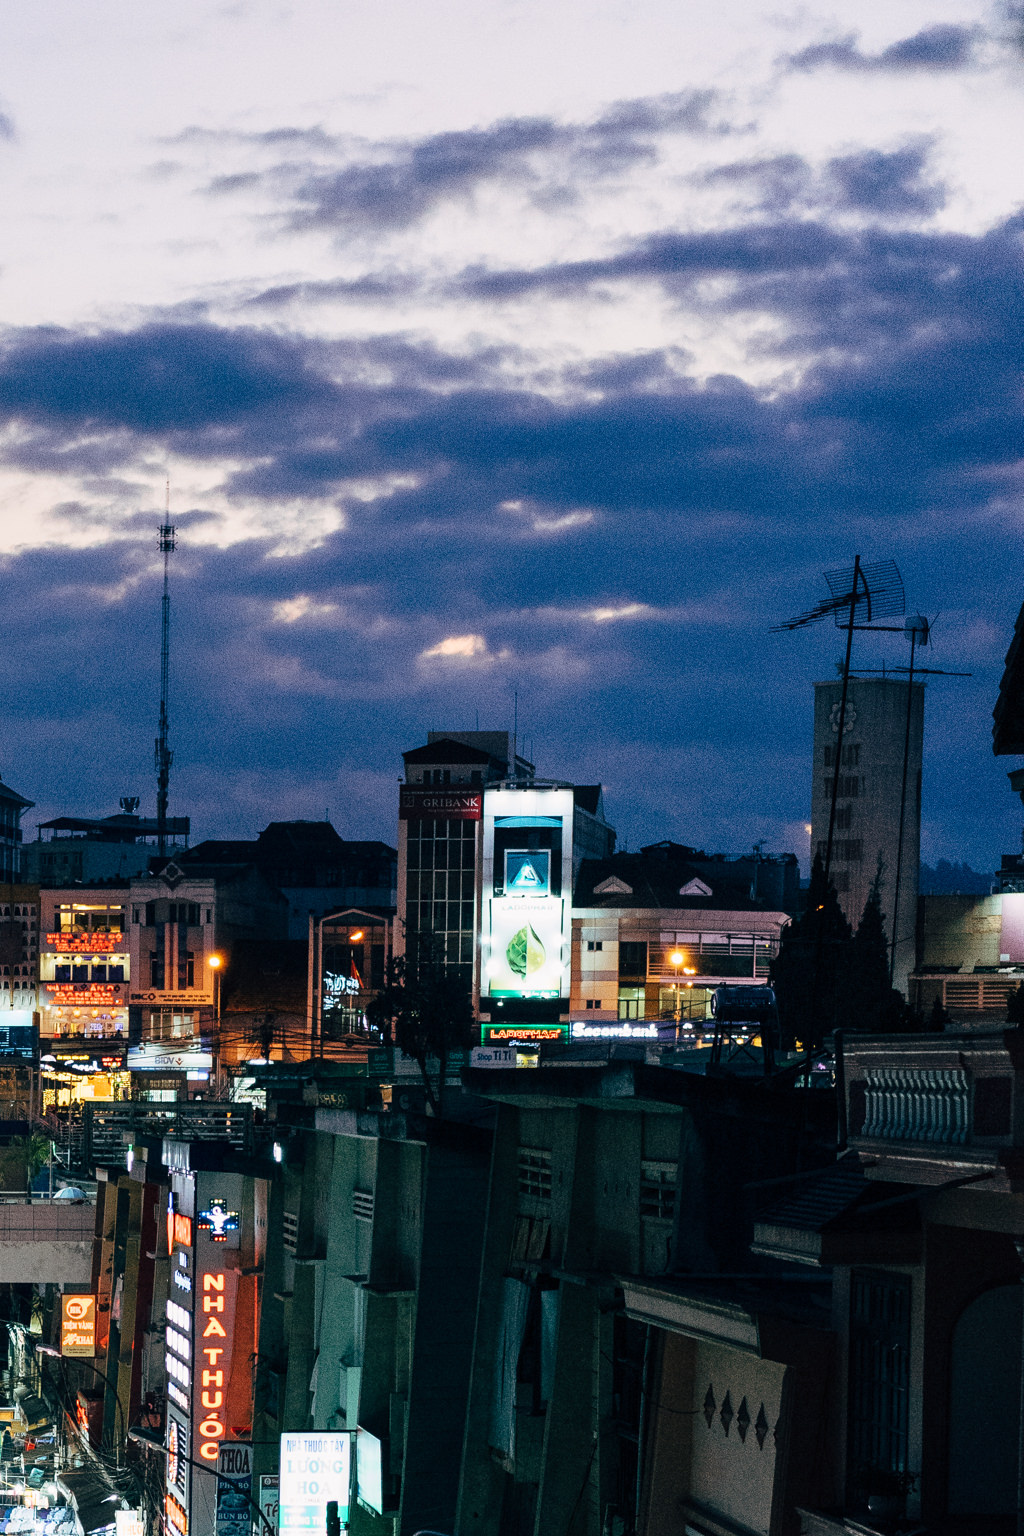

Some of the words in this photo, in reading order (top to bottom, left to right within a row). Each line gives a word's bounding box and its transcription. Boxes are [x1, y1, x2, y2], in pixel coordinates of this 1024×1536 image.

[572, 1022, 658, 1038] Sacombank
[154, 1056, 175, 1065] BIDV
[477, 1053, 493, 1062] Shop
[202, 1273, 227, 1338] NHÀ
[199, 1347, 225, 1461] THUỐC
[219, 1448, 251, 1474] THOA
[296, 1480, 332, 1495] HOA
